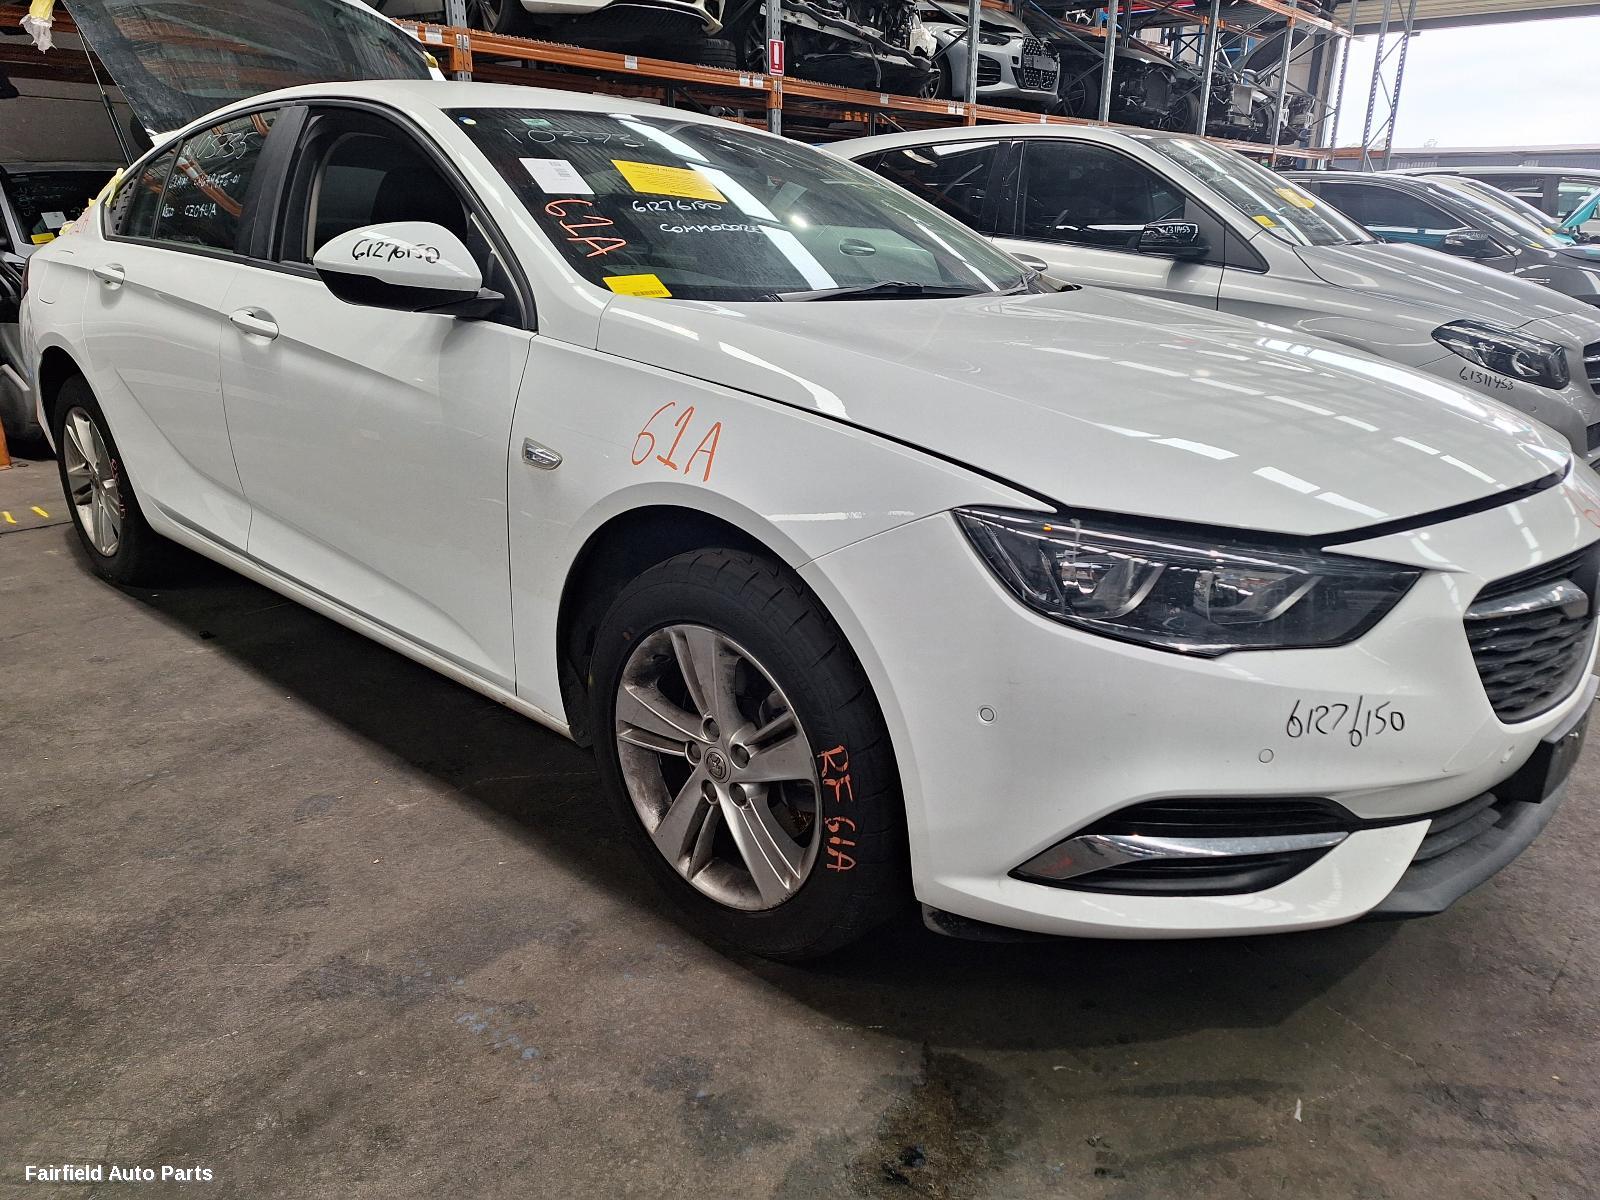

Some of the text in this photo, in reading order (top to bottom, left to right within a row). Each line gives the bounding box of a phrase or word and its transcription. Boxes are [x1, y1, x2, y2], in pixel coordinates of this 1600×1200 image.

[545, 199, 626, 257] 61A
[632, 201, 722, 212] 61276150
[1459, 366, 1514, 391] 61311453
[632, 402, 721, 481] 61A
[1286, 695, 1405, 747] 61276150
